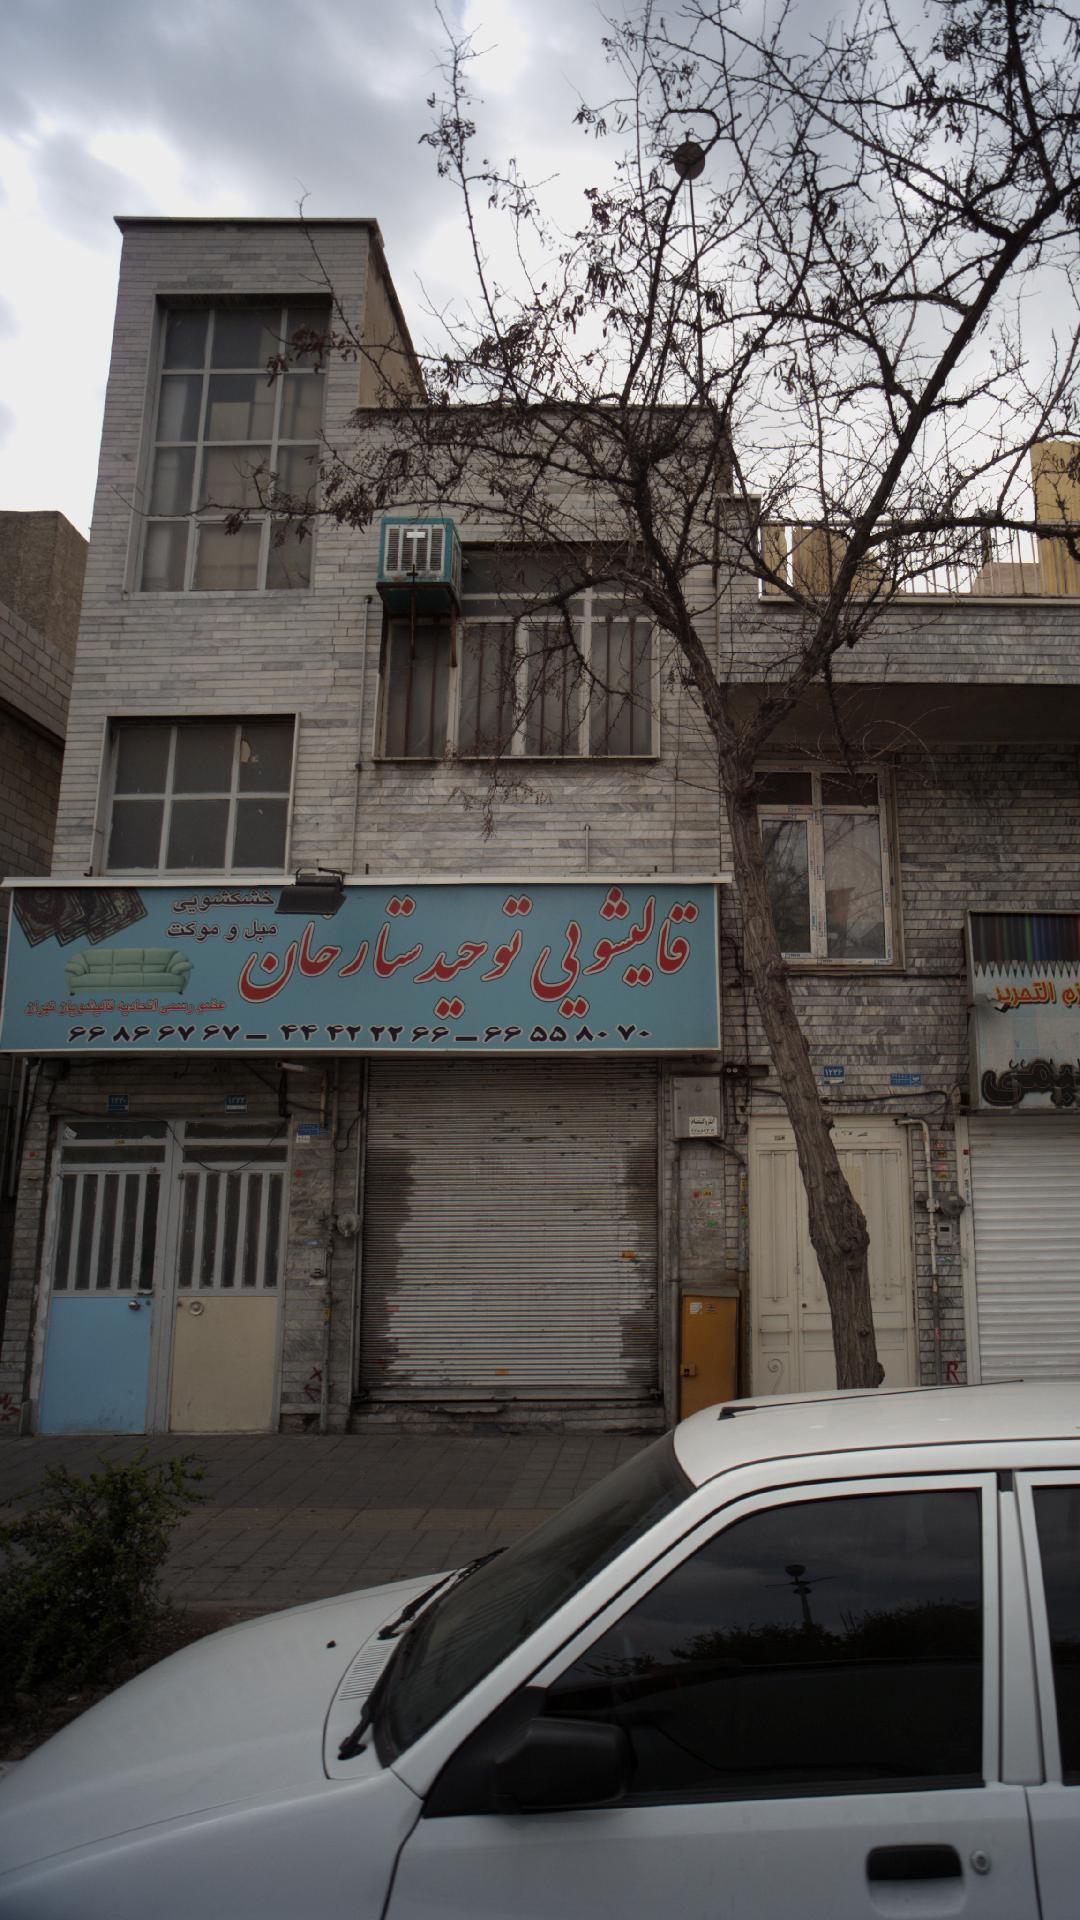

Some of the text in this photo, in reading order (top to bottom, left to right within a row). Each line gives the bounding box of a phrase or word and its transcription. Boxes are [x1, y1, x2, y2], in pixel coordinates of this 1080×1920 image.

[166, 919, 278, 943] مبل و موکت
[172, 888, 275, 913] خشکشویی
[238, 895, 423, 1004] ستارخان
[413, 895, 533, 1020] توحید
